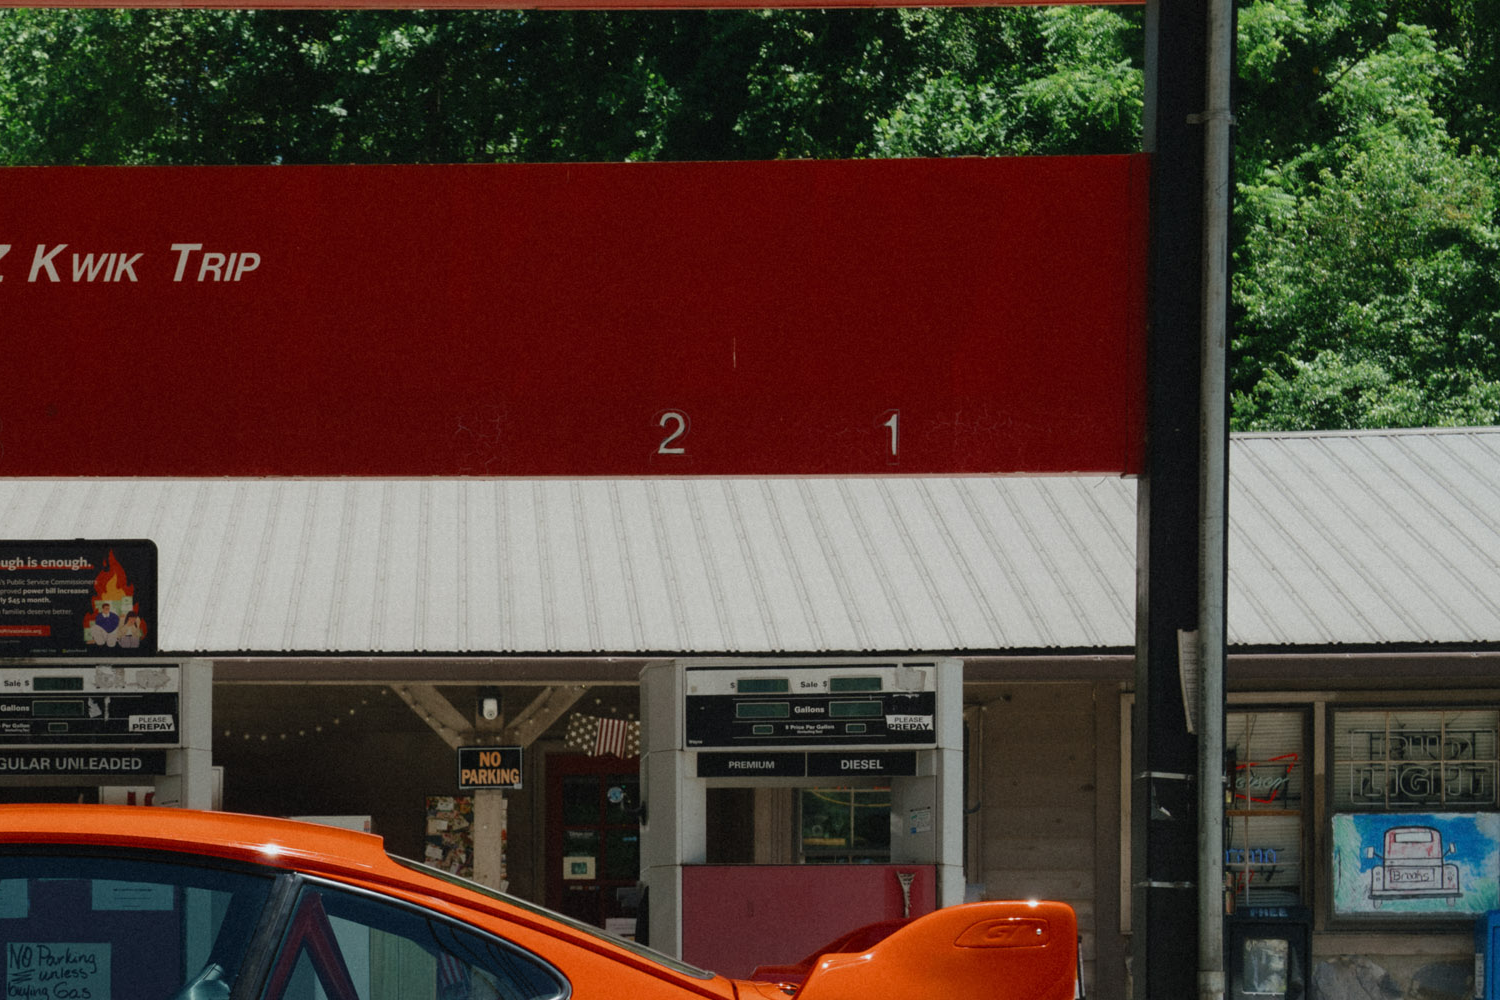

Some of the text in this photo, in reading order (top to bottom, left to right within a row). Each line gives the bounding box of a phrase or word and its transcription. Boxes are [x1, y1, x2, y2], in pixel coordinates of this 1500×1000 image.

[27, 243, 144, 282] KWIK
[170, 243, 261, 282] TRIP
[658, 411, 685, 454] 2
[884, 413, 897, 456] 1
[27, 556, 37, 567] is
[40, 556, 92, 571] enough.
[22, 588, 44, 596] power
[57, 587, 89, 595] increases
[4, 679, 30, 687] Sale $
[730, 681, 735, 689] $
[0, 704, 30, 712] Gallons
[794, 706, 825, 714] Gallons
[132, 723, 173, 731] PREPAY
[888, 722, 930, 731] PREPAY
[55, 757, 142, 771] UNLEADED
[479, 751, 501, 767] NO
[728, 759, 884, 770] PREMIUM DIESEL
[461, 768, 519, 785] PARKING
[1360, 767, 1489, 797] LIGHT
[1250, 907, 1288, 917] FREE
[9, 943, 98, 973] NO Parking
[39, 966, 89, 982] unless
[53, 980, 92, 999] Gas
